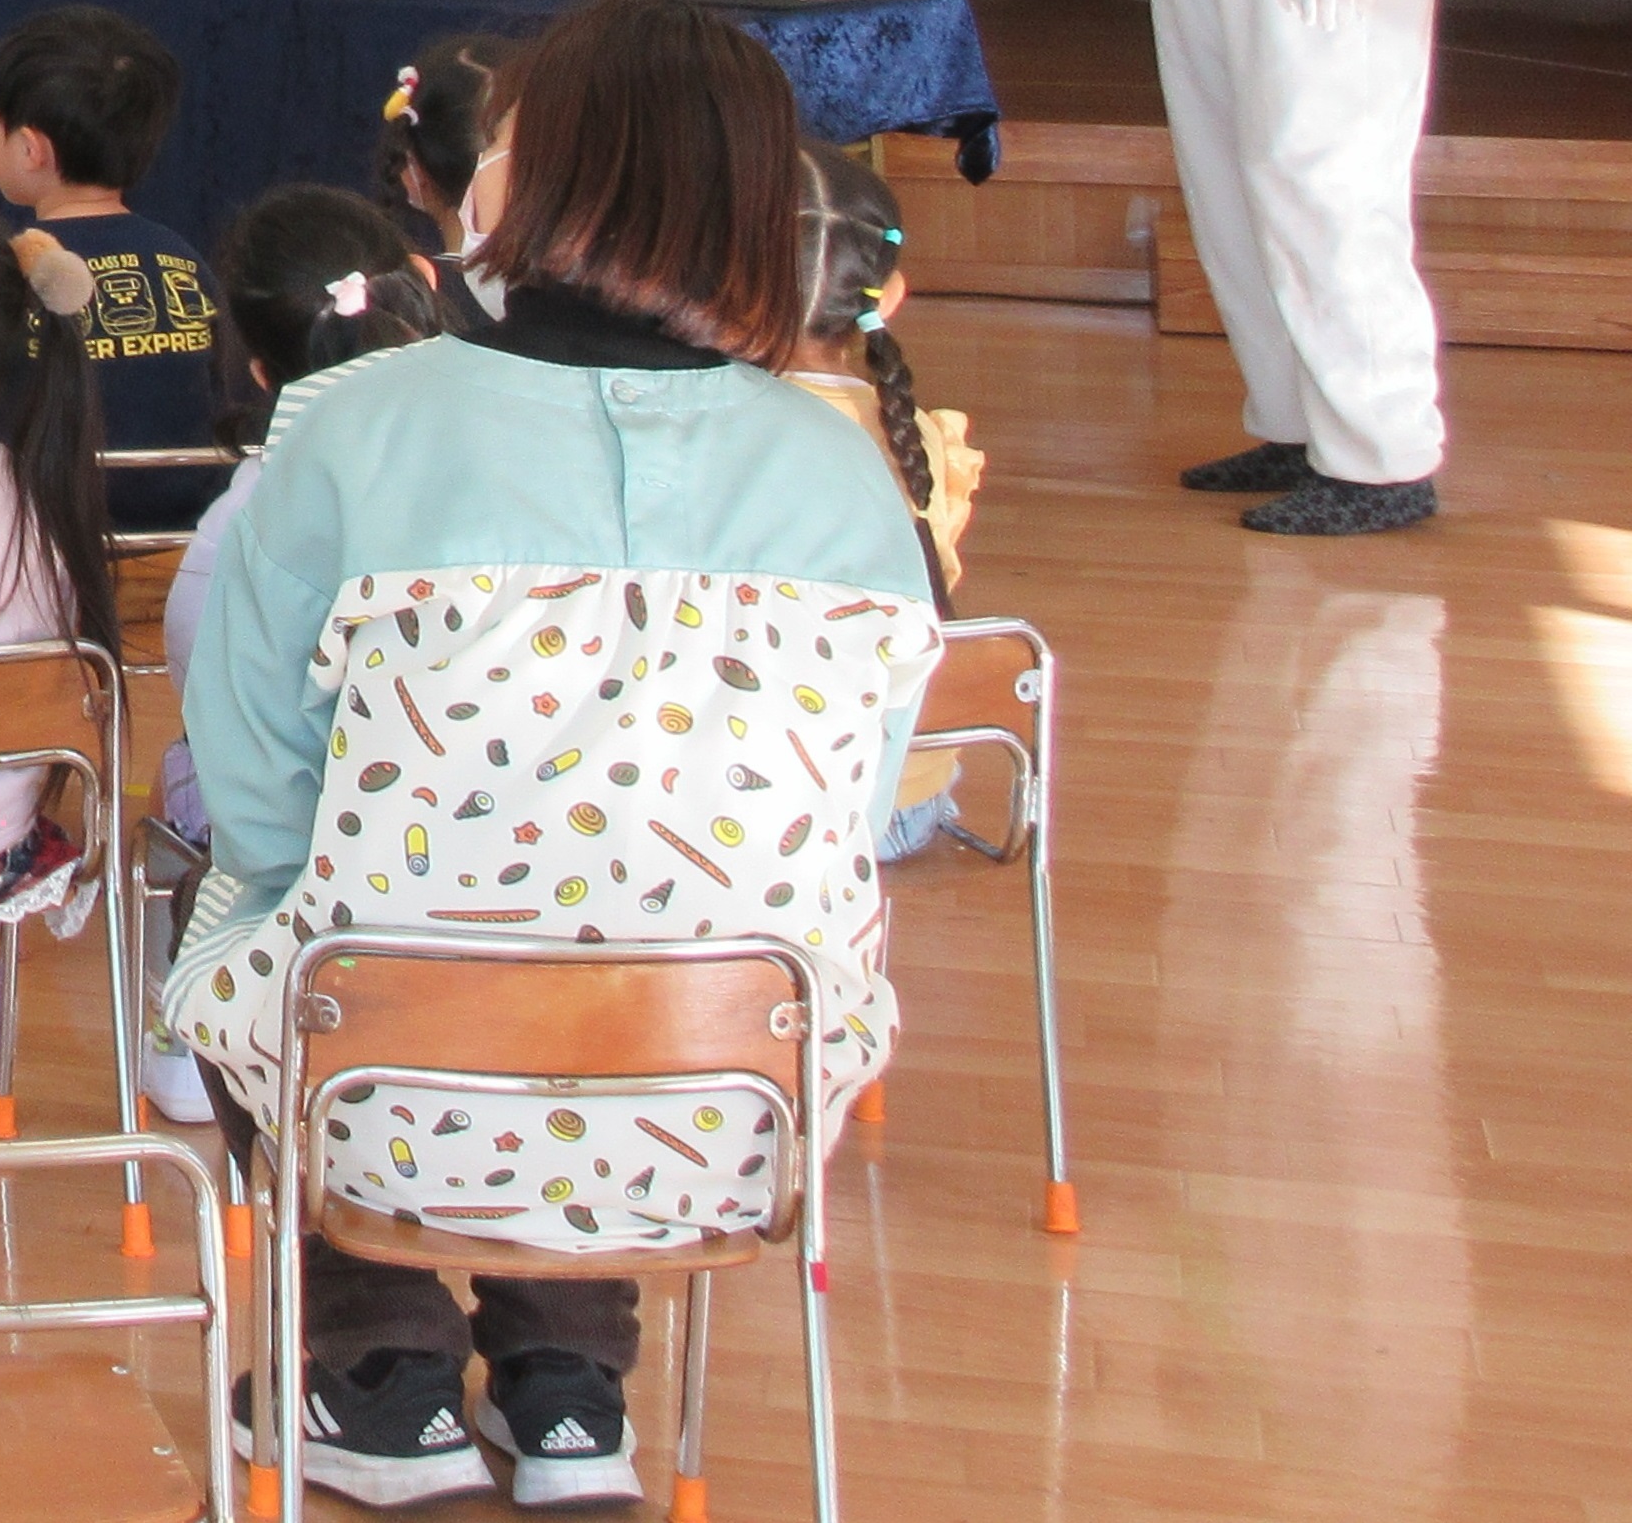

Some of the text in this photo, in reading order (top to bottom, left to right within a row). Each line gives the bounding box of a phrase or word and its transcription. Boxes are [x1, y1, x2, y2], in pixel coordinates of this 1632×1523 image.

[88, 255, 119, 271] CLASS
[123, 329, 212, 356] EXPRES
[540, 1436, 595, 1450] adidas
